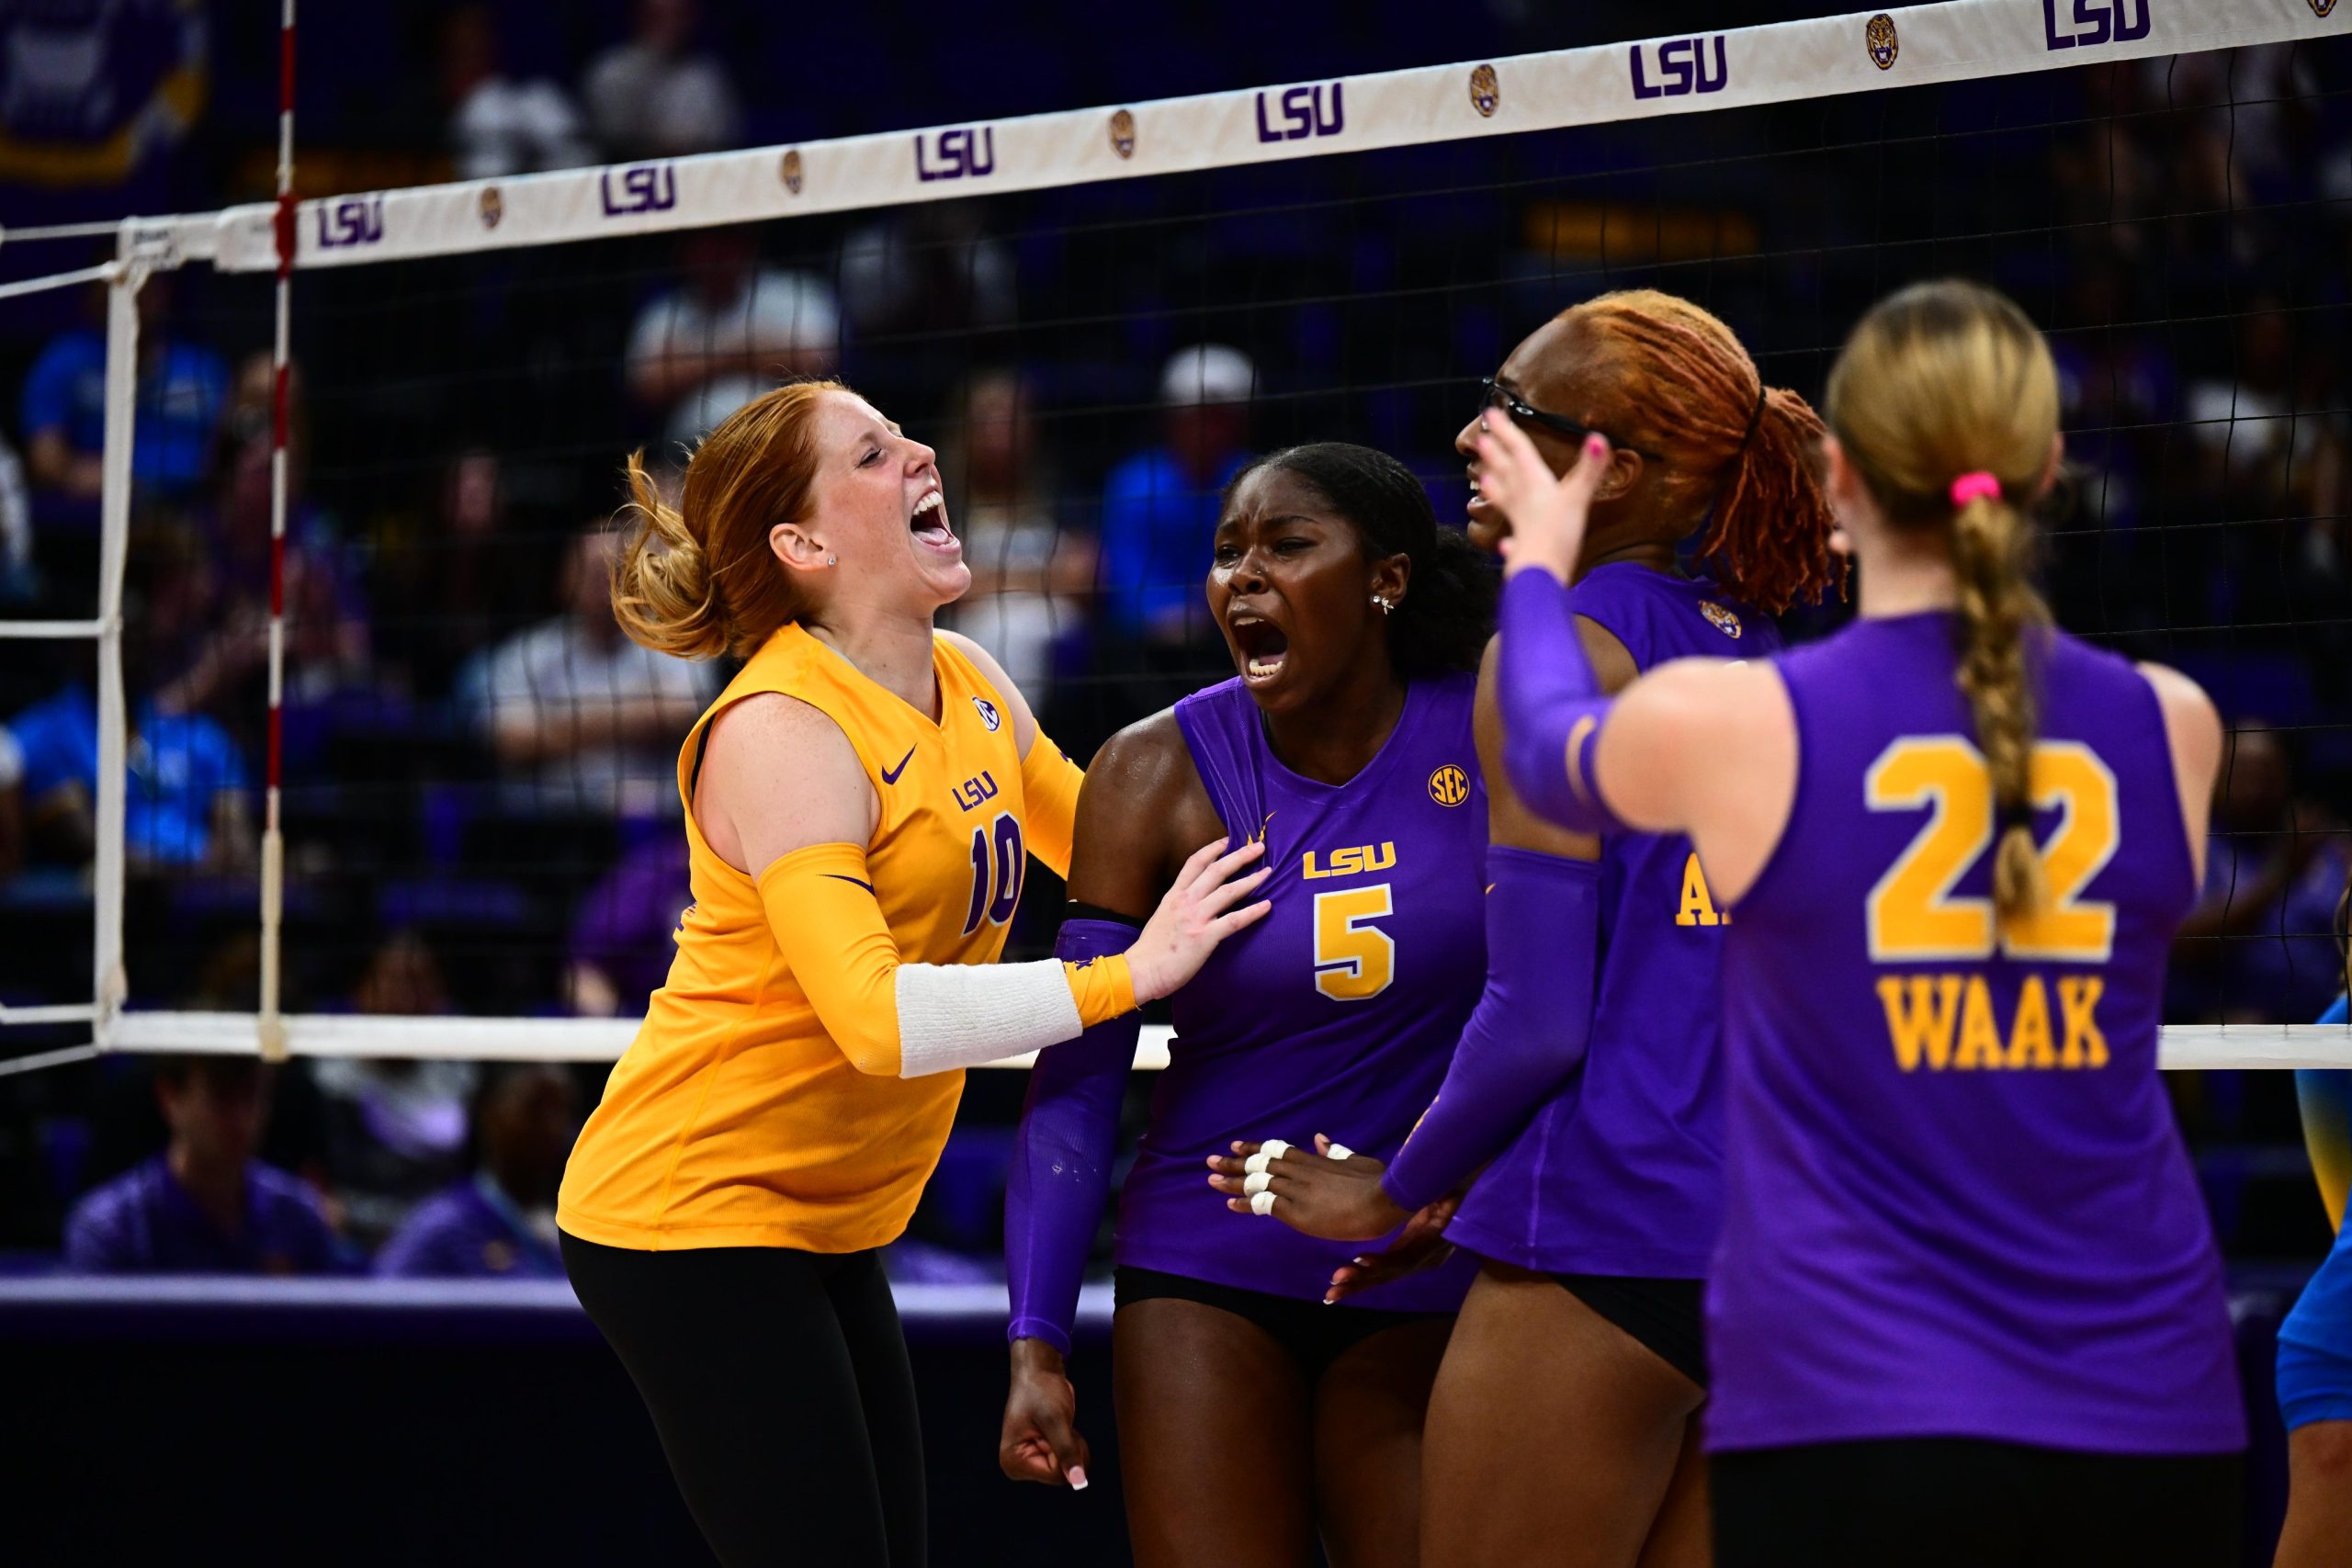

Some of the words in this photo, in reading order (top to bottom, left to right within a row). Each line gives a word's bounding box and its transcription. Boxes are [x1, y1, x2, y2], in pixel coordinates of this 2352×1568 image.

[2042, 0, 2151, 51] LSU
[1630, 35, 1727, 100] LSU
[1256, 83, 1344, 142] LSU
[915, 126, 995, 182] LSU
[602, 165, 676, 216] LSU
[318, 197, 383, 249] LSU
[952, 770, 999, 812] LSU
[1431, 767, 1466, 804] SEC
[960, 808, 1024, 936] 10
[1303, 840, 1396, 880] LSU
[1864, 733, 2120, 964] 22
[1314, 883, 1396, 1002] 5
[1875, 974, 2110, 1073] WAAK
